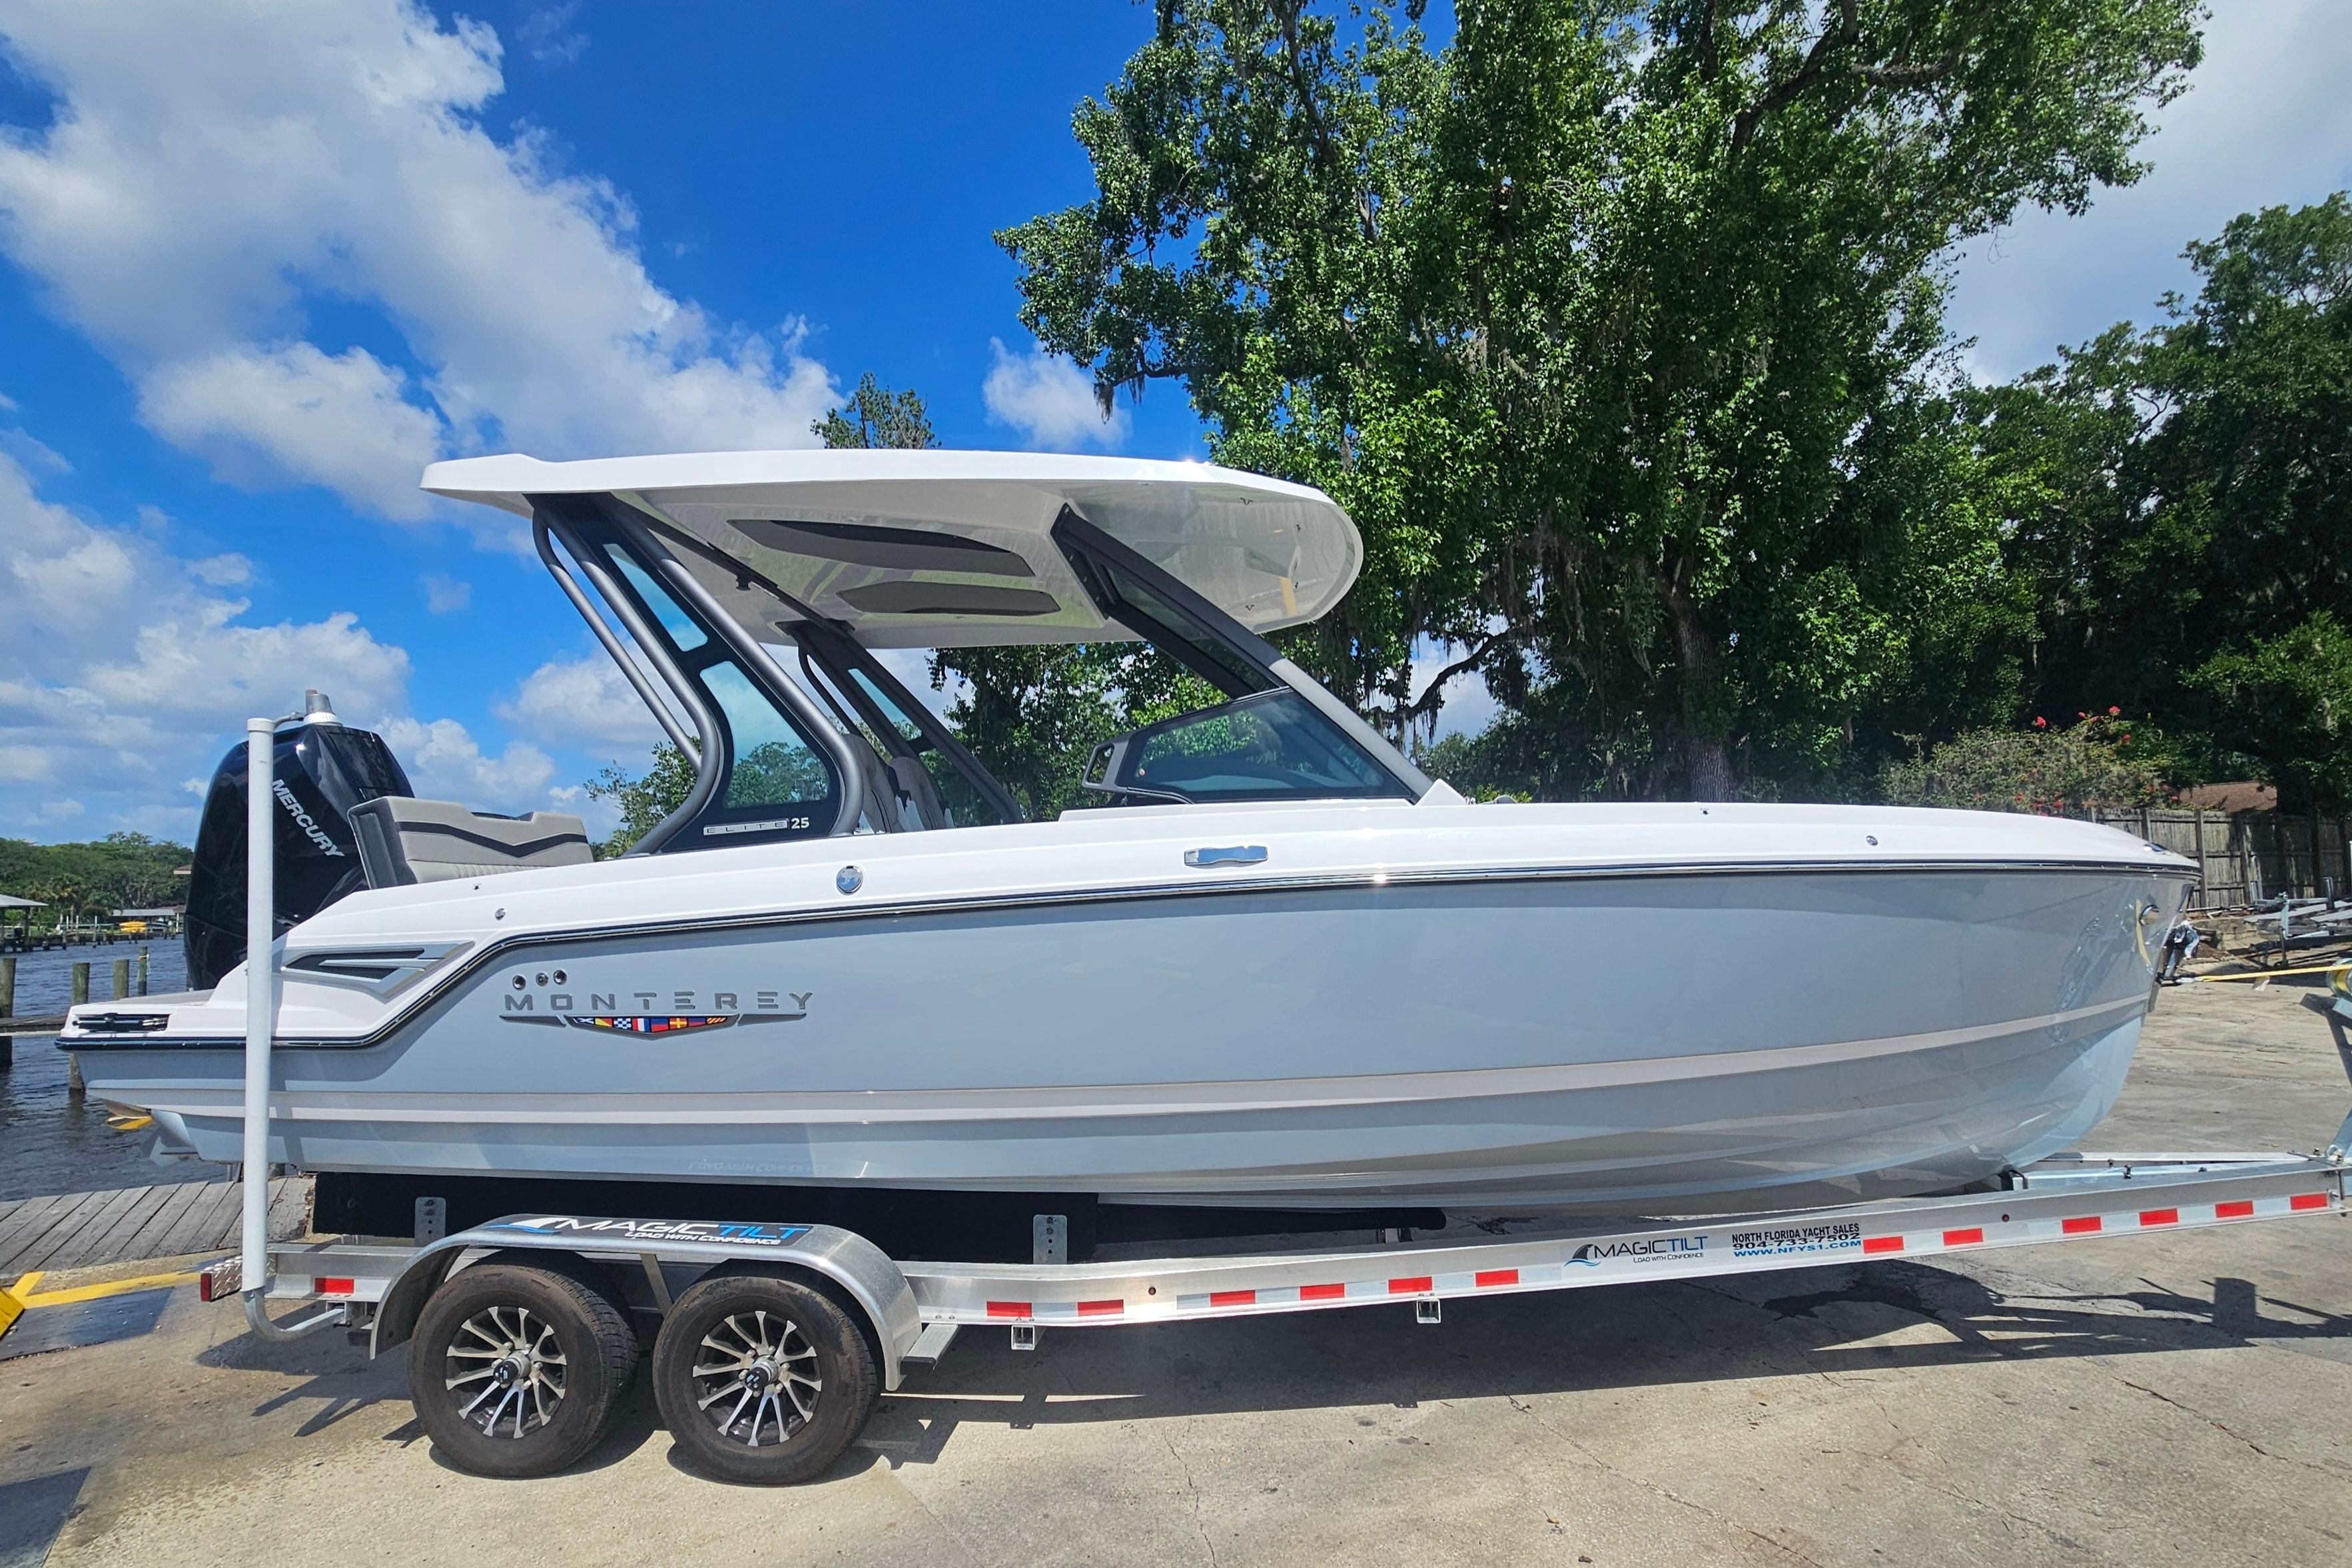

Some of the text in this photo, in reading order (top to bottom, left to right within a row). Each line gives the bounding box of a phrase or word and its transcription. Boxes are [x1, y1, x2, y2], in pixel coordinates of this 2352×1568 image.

[272, 779, 345, 857] MERCURY
[706, 817, 810, 834] ELITE 25
[504, 990, 813, 1010] MONTEREY
[699, 1235, 781, 1245] CONFIDENCE
[1732, 1223, 1860, 1244] NORTH FLORIDA YACHT SALES
[1733, 1232, 1860, 1250] 904-733-7502
[1667, 1252, 1705, 1261] CONFIDENCE
[1733, 1240, 1862, 1258] WWW.NFYS1.COM
